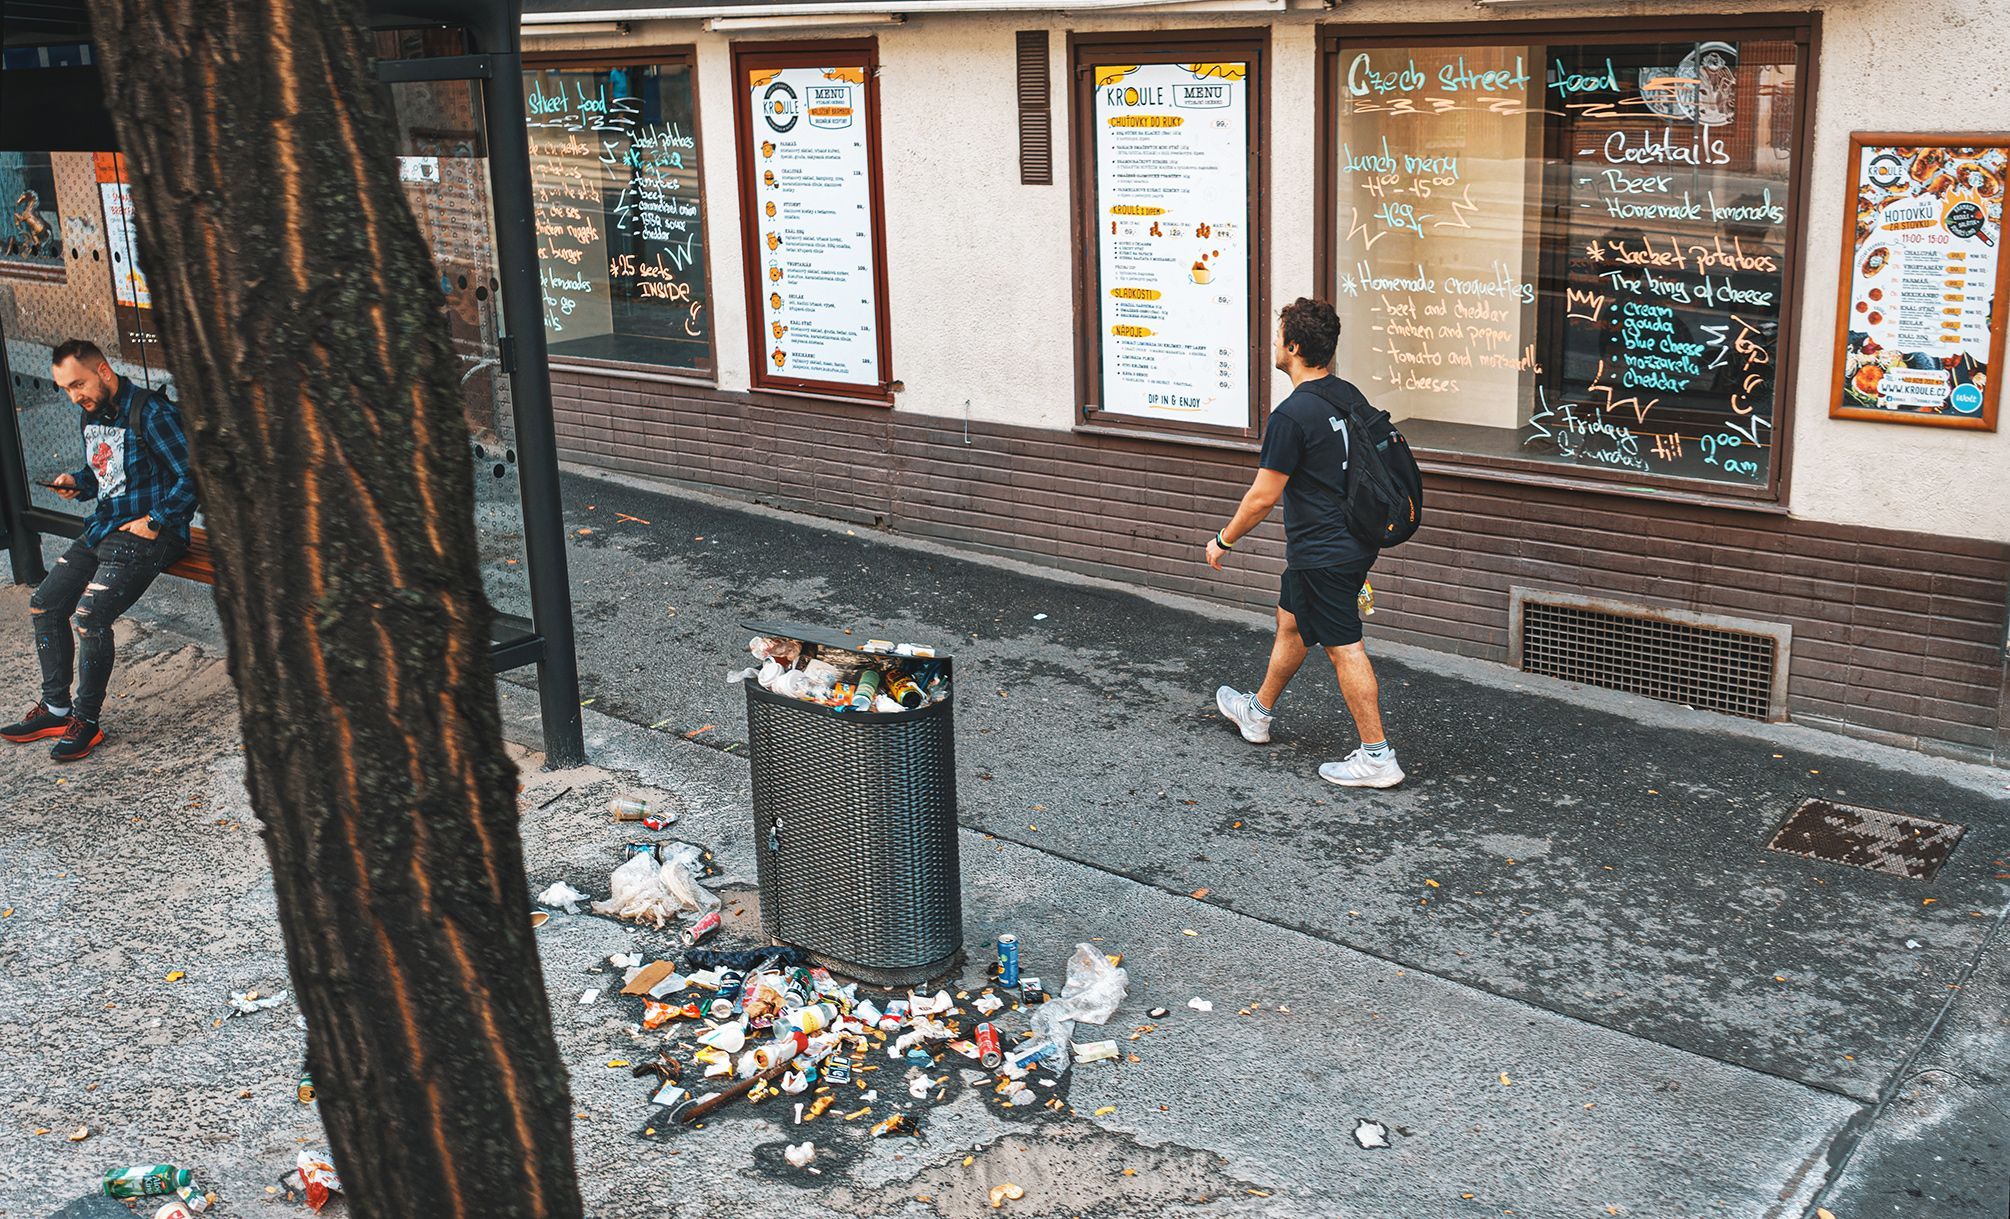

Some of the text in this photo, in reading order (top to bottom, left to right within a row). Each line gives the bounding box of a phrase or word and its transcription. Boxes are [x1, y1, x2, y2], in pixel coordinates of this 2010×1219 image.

[1348, 53, 1426, 96] Czech
[1548, 58, 1621, 98] food
[577, 81, 607, 126] food
[815, 88, 845, 99] MENU
[1107, 86, 1222, 107] KROULE MENU
[763, 100, 799, 115] KROULE
[1150, 116, 1160, 127] DO
[1604, 124, 1731, 165] Cocktails
[1868, 166, 1903, 176] KROULE
[1601, 169, 1673, 195] Beer
[638, 185, 666, 202] beef
[1605, 188, 1785, 224] Homemade lemonades
[1884, 207, 1934, 223] HOTOVKU
[1889, 220, 1931, 231] ZA STOVKU
[1928, 234, 1950, 244] 15:00
[1357, 259, 1535, 304] Homemade croquettes
[1599, 268, 1774, 307] The king of cheese
[637, 282, 691, 302] INSIDE
[1114, 288, 1152, 299] SLADKOSTI
[561, 296, 576, 316] go
[1381, 294, 1510, 323] beef and cheddar
[1623, 301, 1674, 319] cream
[1116, 324, 1143, 337] NÁPOJE
[1438, 322, 1465, 340] and
[1623, 317, 1675, 337] gouda
[1621, 328, 1656, 351] blue
[1387, 338, 1443, 366] tomato
[1448, 347, 1473, 369] and
[1405, 372, 1461, 394] cheeses
[1881, 383, 1947, 397] WWW.KROULE.CZ
[1148, 394, 1159, 404] DIP
[1161, 395, 1169, 405] IN
[1179, 397, 1200, 408] ENJOY
[1557, 404, 1639, 456] Friday
[1651, 432, 1683, 461] till
[1724, 459, 1758, 478] am
